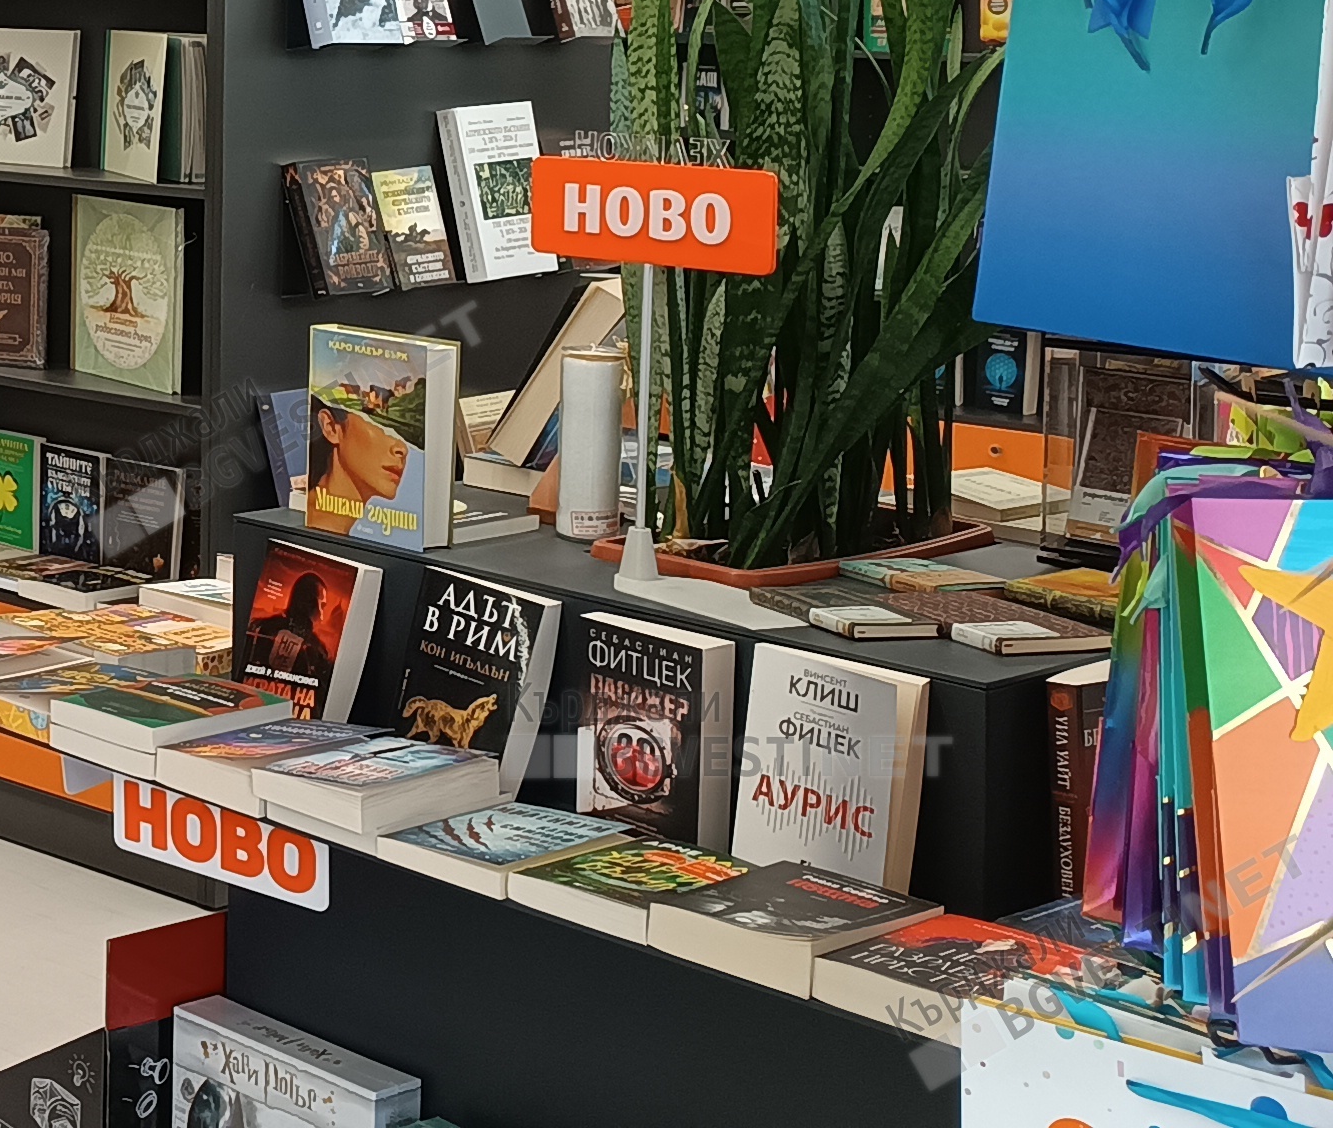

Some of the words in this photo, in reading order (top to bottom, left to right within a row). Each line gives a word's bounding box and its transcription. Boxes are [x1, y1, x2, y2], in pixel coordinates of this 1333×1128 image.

[563, 182, 732, 245] НОВО
[328, 339, 353, 351] КАРО
[315, 487, 364, 520] Минали
[367, 501, 418, 537] години
[437, 582, 518, 631] АДЪТ
[423, 606, 440, 633] В
[446, 612, 518, 663] РИМ
[590, 627, 693, 665] СЕБАСТИАН
[419, 640, 447, 658] КОН
[449, 650, 510, 683] ИГЪЛДЪН
[588, 639, 693, 693] ФИТЦЕК
[803, 668, 848, 688] ВИНСЕНТ
[294, 690, 315, 707] НА
[788, 674, 859, 714] КЛИШ
[778, 716, 862, 760] ФИЦЕК
[793, 711, 850, 735] СЕБАСТИАН
[1055, 716, 1070, 746] УИЛ
[1056, 750, 1071, 790] УАЙТ
[751, 774, 876, 839] АУРИС
[123, 778, 317, 895] НОВО
[1058, 806, 1074, 899] БЕЗДУХОВЕН
[220, 1040, 260, 1087] Хари
[263, 1058, 318, 1111] Потър
